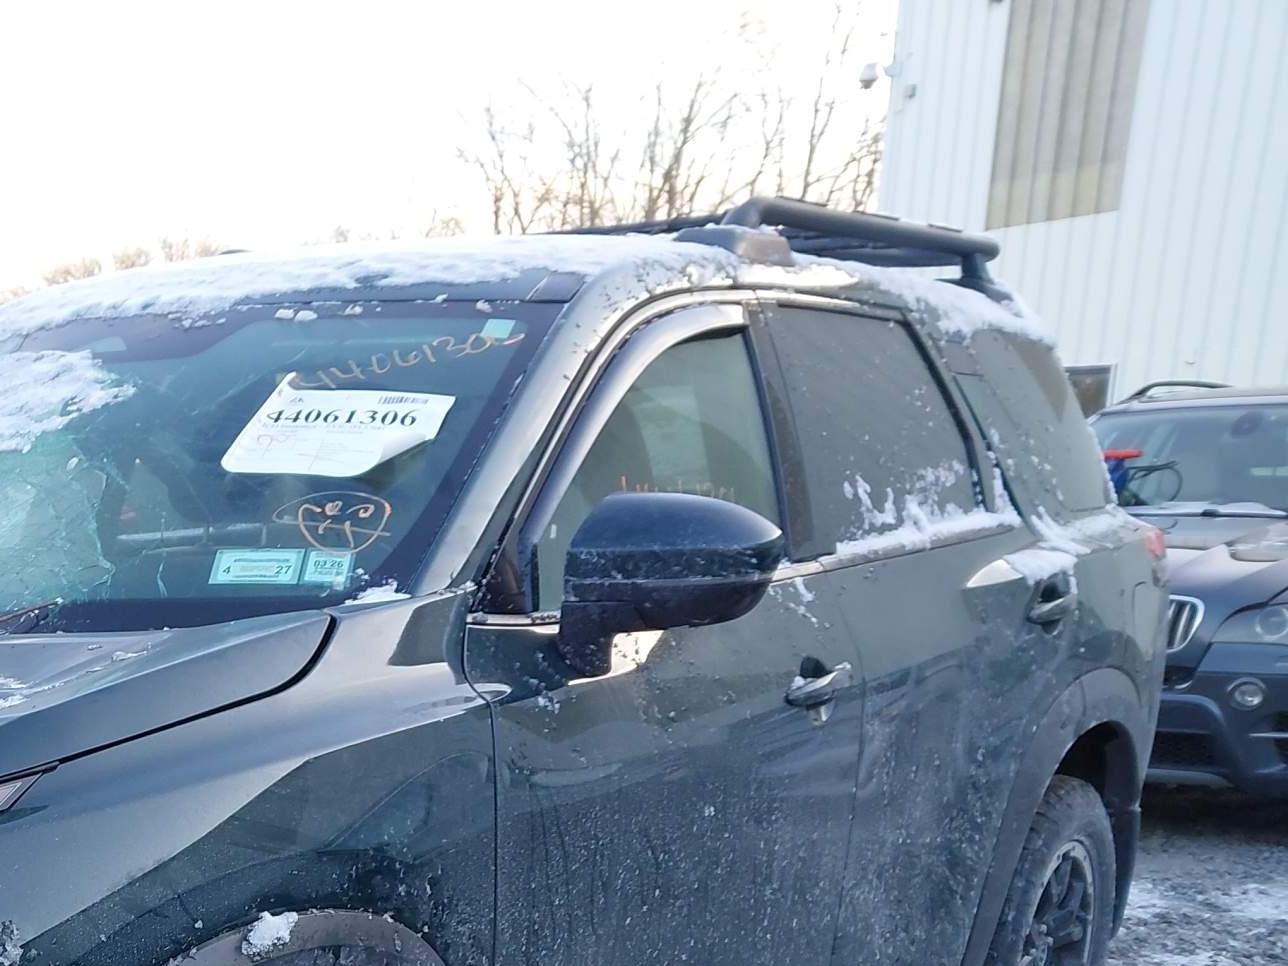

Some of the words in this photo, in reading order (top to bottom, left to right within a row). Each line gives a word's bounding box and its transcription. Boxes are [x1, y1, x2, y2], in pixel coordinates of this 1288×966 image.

[266, 408, 418, 427] 44061306
[223, 565, 232, 575] 4
[275, 565, 292, 575] 27
